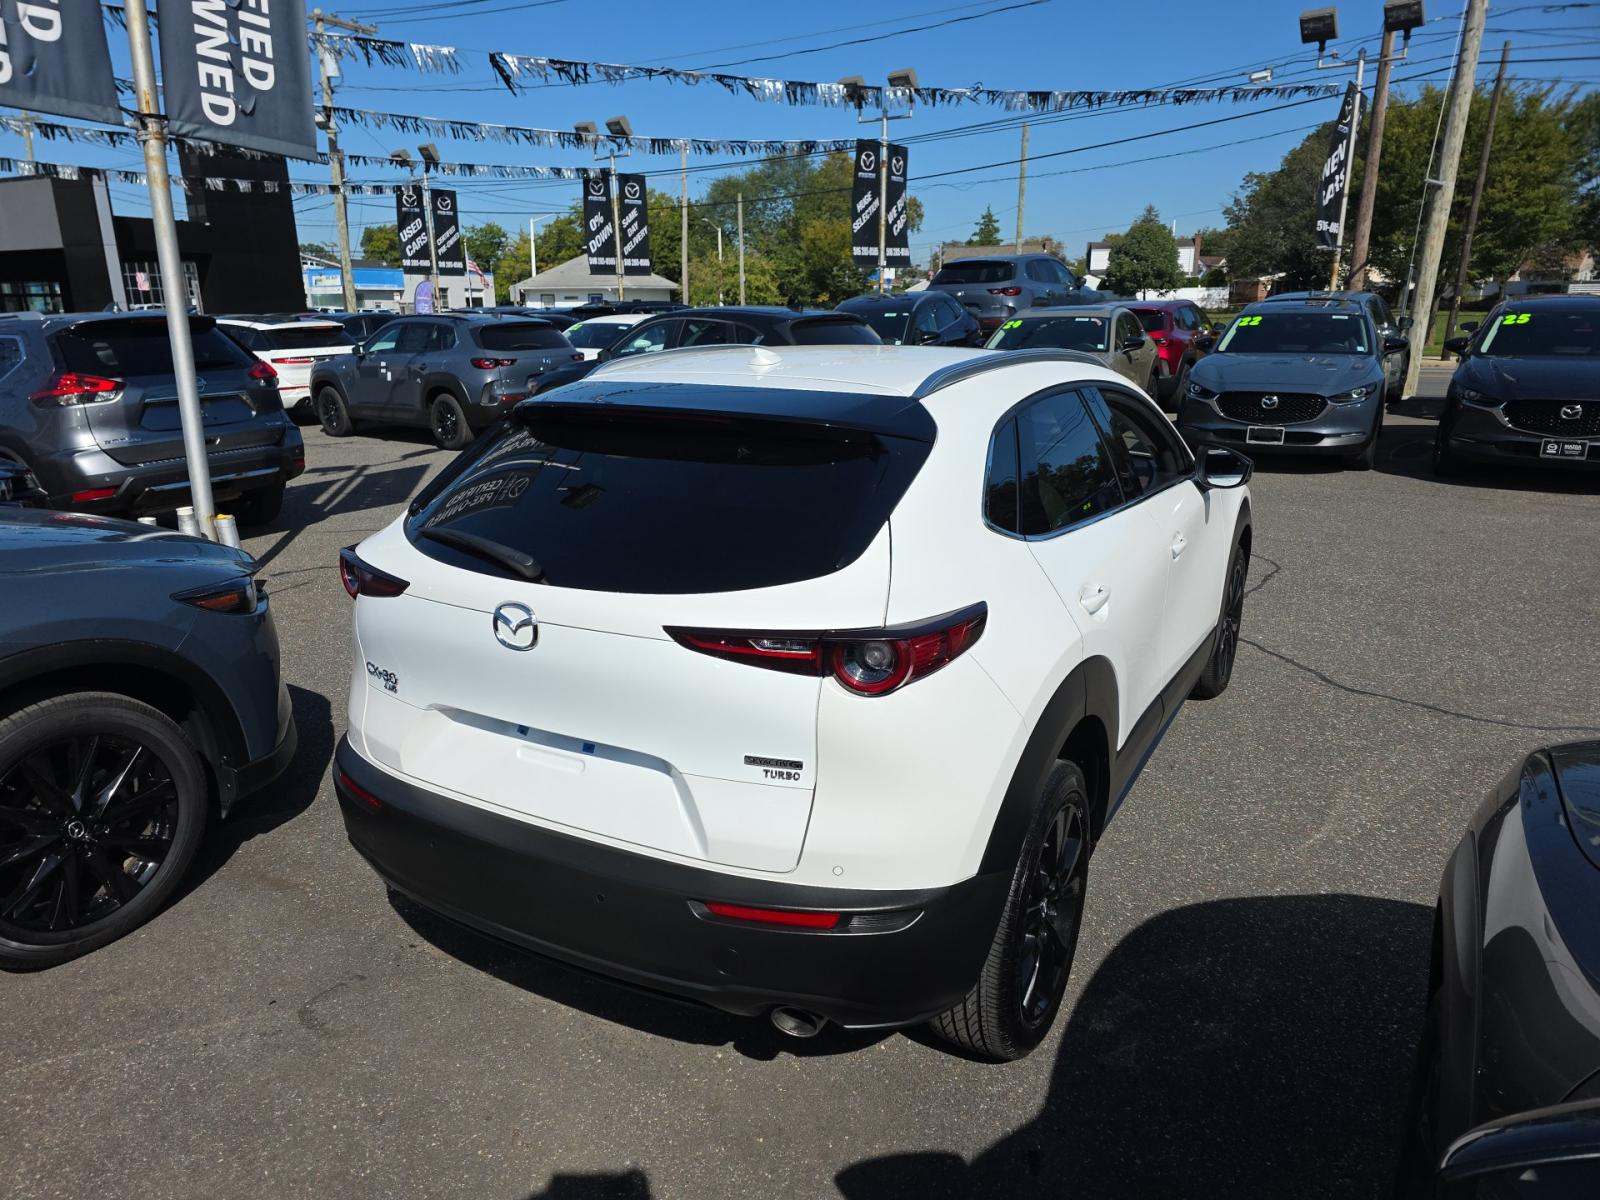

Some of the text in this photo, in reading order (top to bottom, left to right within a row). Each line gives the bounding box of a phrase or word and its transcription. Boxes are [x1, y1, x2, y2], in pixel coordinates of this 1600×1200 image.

[590, 211, 604, 232] 0%
[621, 207, 638, 228] SAME
[400, 218, 422, 242] USED
[588, 222, 613, 254] DOWN
[627, 221, 639, 237] DAY
[405, 232, 428, 256] CARS
[623, 225, 648, 255] DELIVERY
[1238, 316, 1262, 326] 22
[1503, 313, 1531, 325] 25
[763, 768, 801, 781] TURBO
